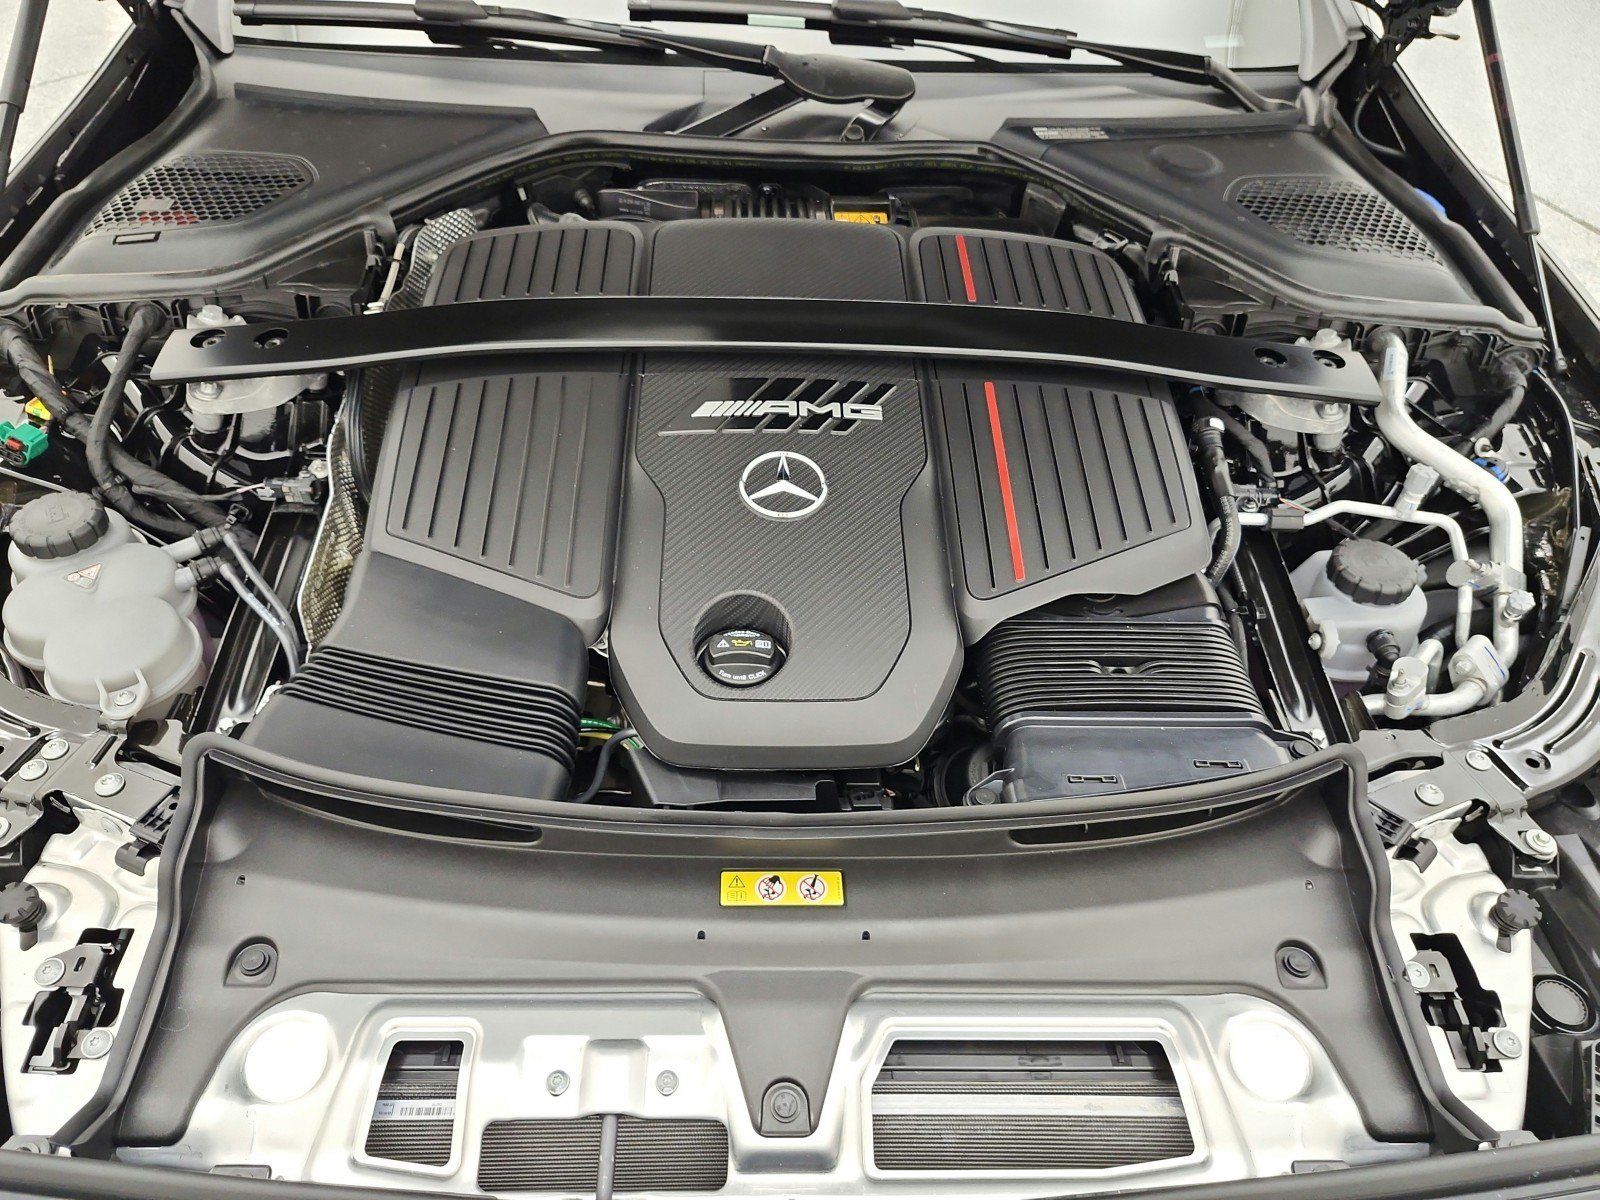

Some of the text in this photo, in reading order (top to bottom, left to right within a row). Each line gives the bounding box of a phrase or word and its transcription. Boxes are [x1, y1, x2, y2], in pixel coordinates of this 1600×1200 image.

[752, 400, 883, 422] AMG
[718, 669, 731, 679] Turn
[748, 670, 766, 680] CLICK
